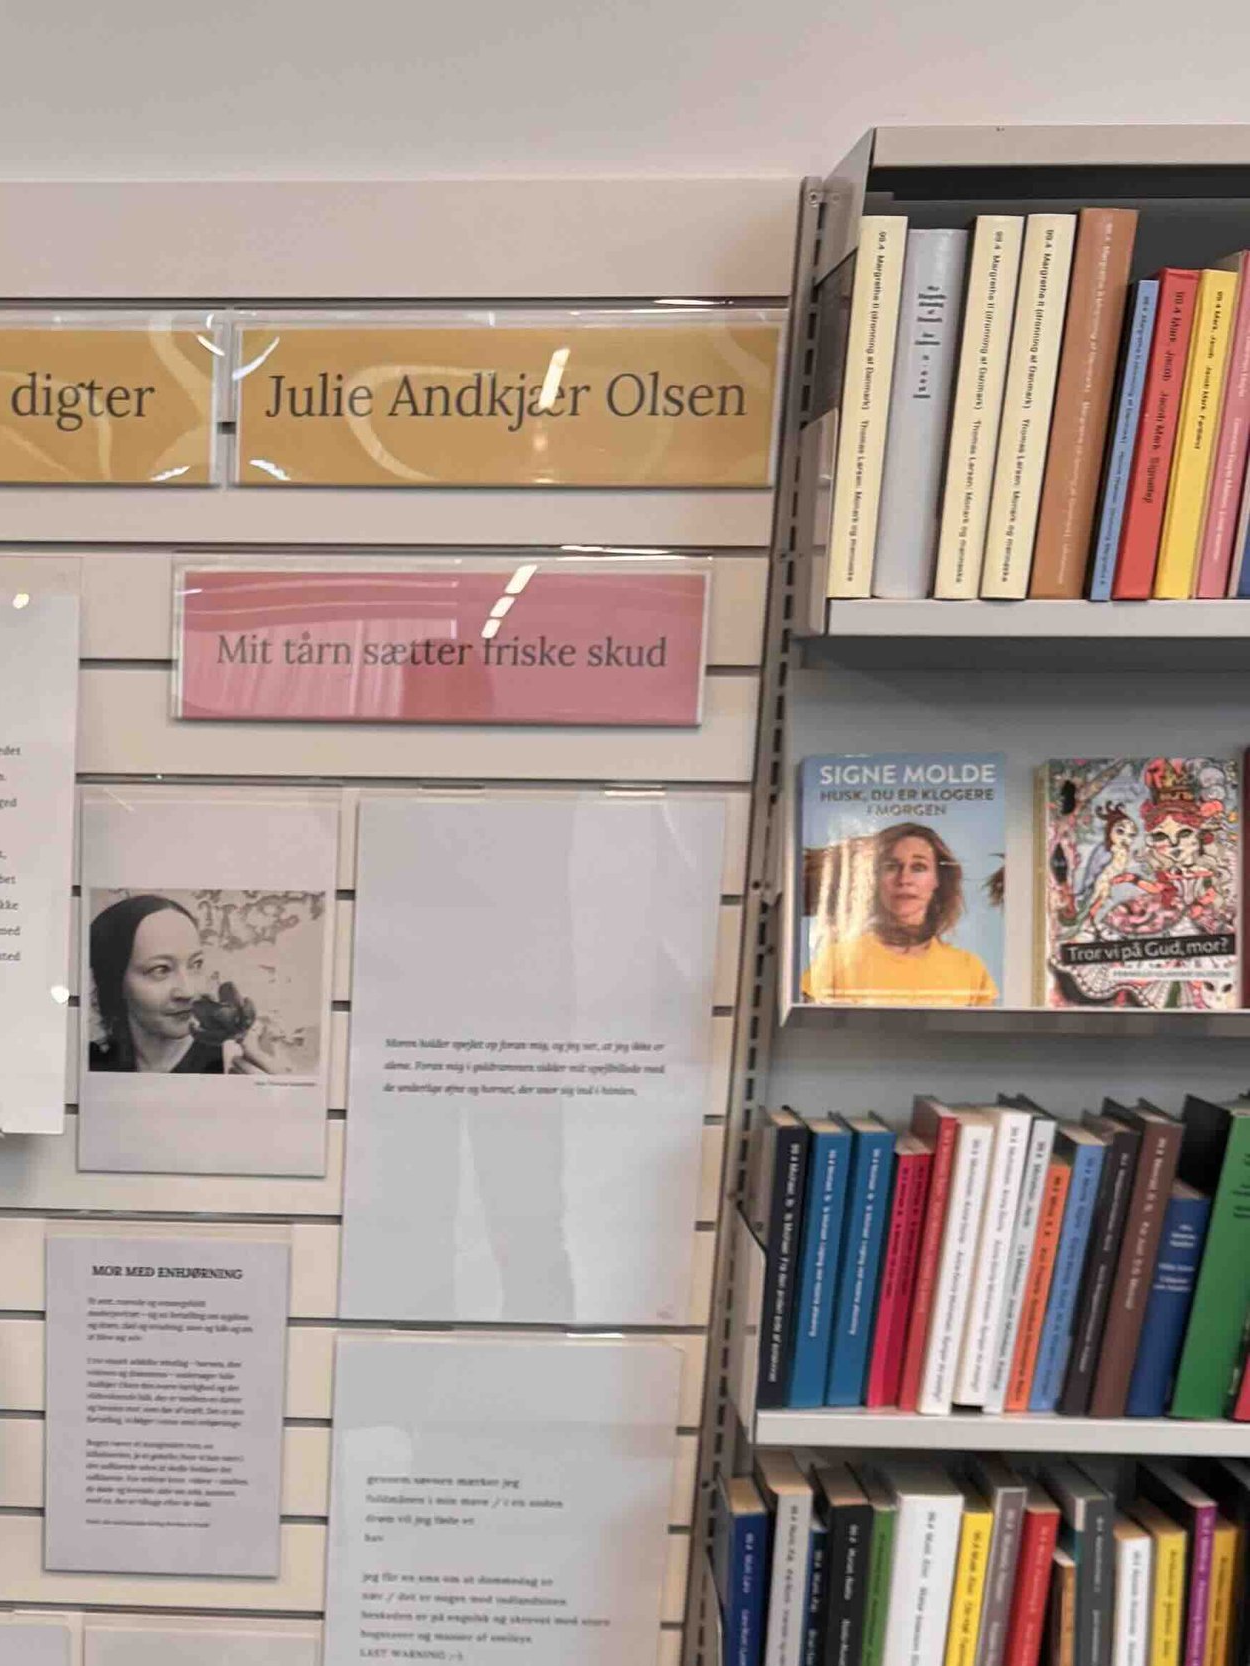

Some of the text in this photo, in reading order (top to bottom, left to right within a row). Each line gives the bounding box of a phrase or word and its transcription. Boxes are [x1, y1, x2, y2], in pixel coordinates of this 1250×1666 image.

[10, 371, 155, 433] digter
[264, 373, 749, 432] Julie Andkjær Olsen
[216, 630, 667, 668] Mit tårn sætter friske skud
[819, 763, 998, 785] SIGNE MOLDE
[871, 789, 893, 801] DU
[898, 788, 918, 800] ER
[921, 788, 995, 801] KLOGERE
[874, 803, 948, 816] MORGEN
[1068, 937, 1229, 962] Tror vi på Gud, mor?
[92, 1265, 122, 1276] MOR
[125, 1266, 155, 1277] MED
